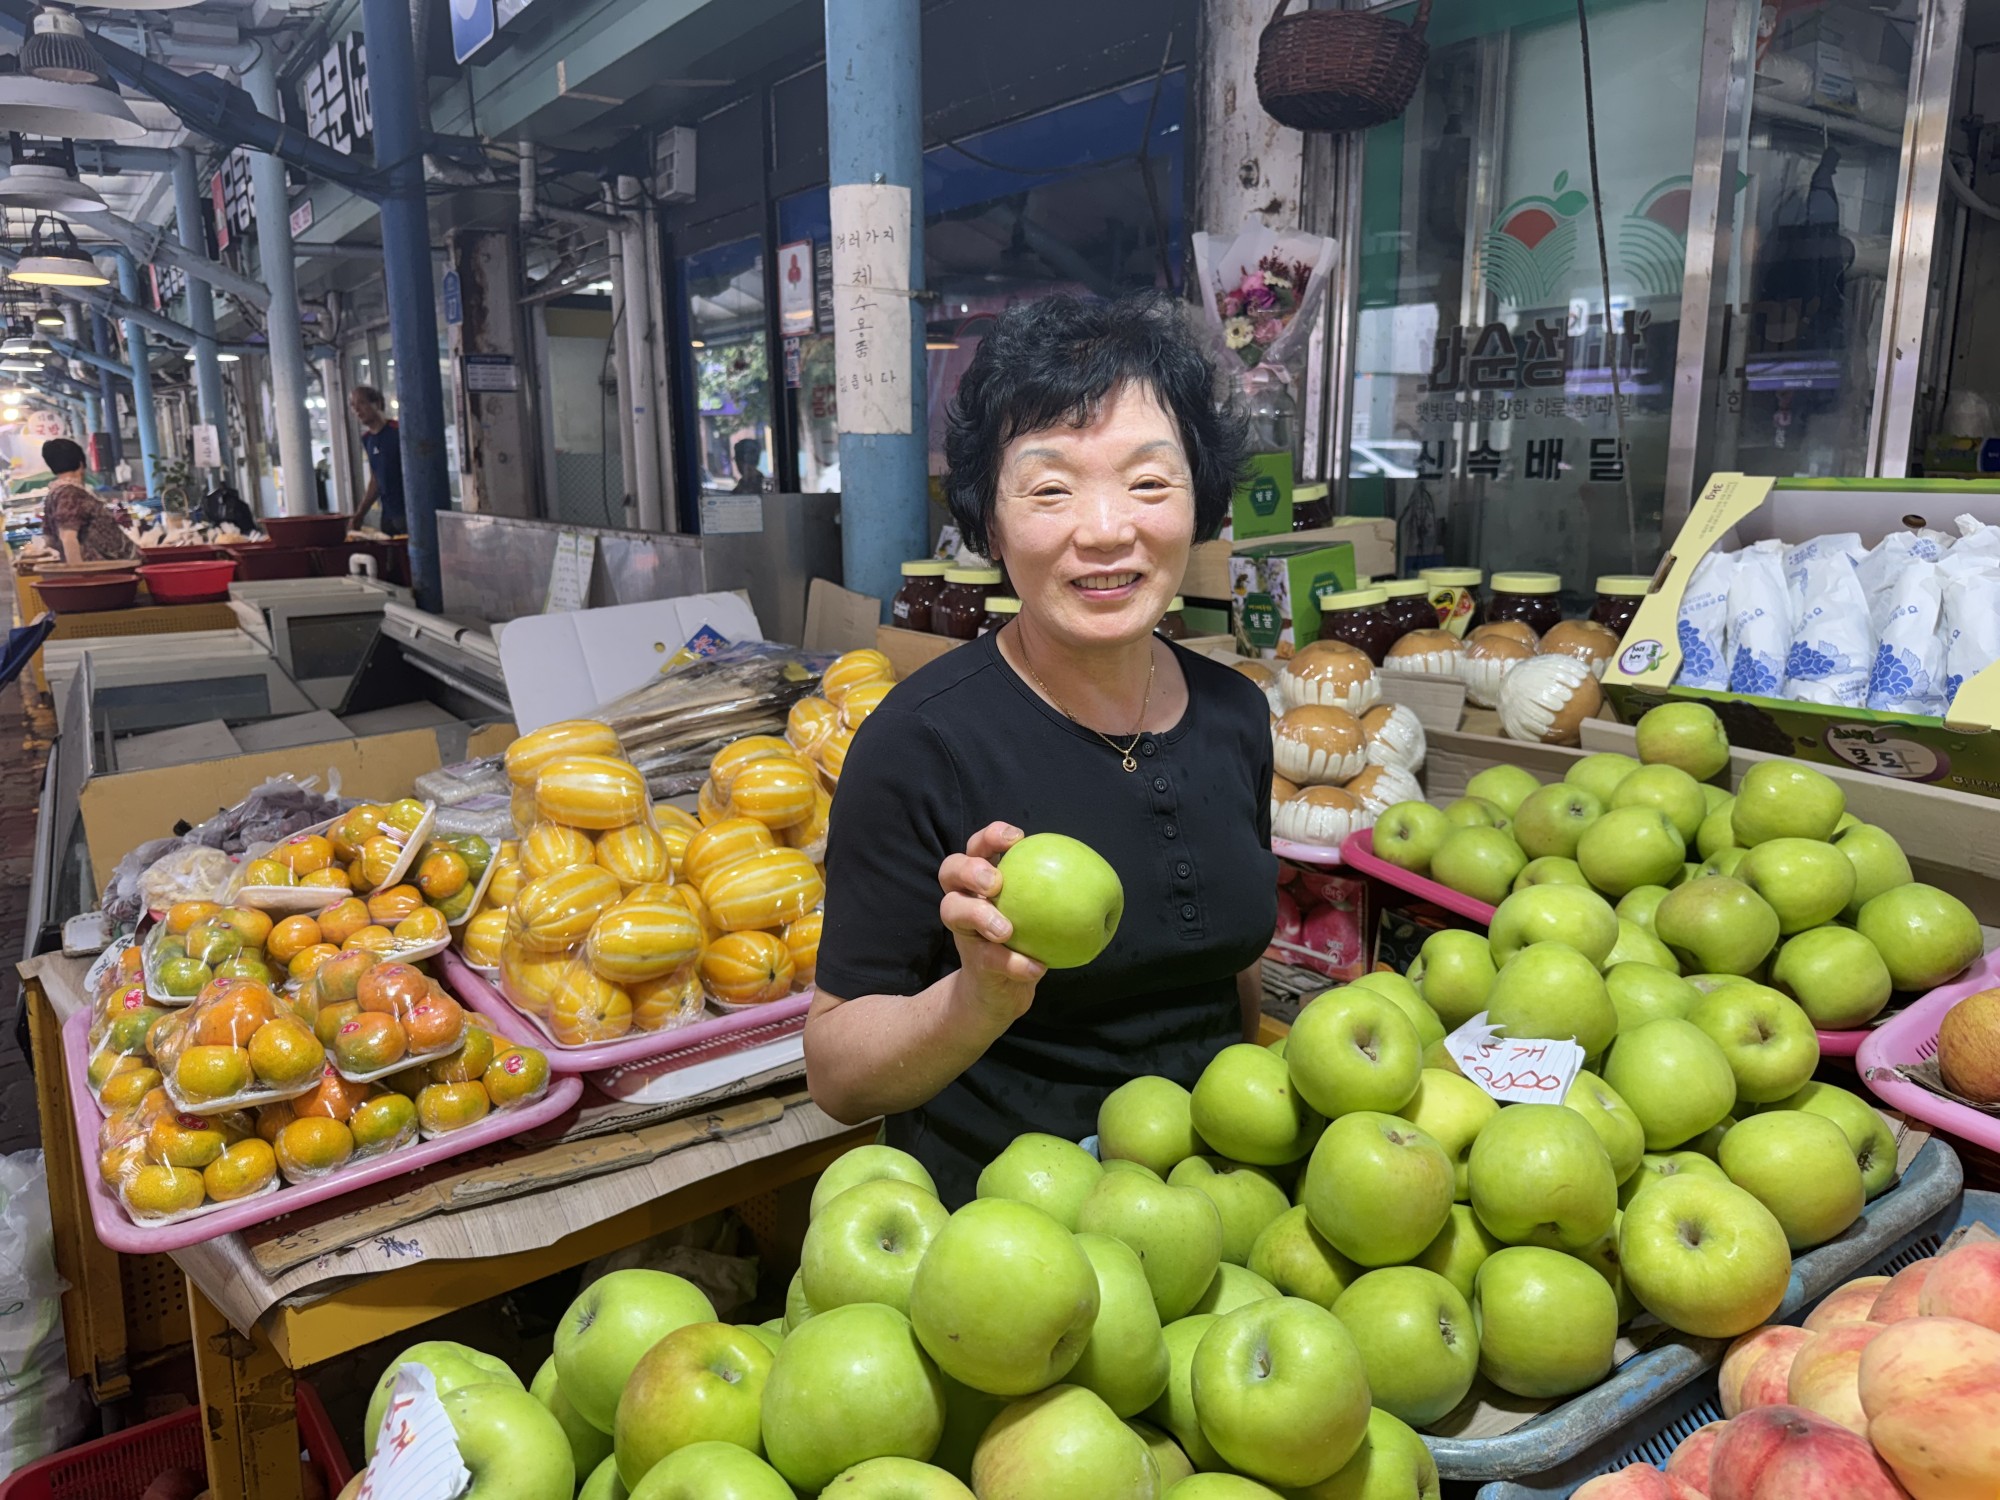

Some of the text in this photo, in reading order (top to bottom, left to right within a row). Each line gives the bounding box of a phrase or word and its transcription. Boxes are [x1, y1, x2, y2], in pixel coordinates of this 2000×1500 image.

[849, 264, 878, 359] 제수용품
[1705, 483, 1724, 501] 3kg
[1249, 612, 1274, 629] 벌꿀
